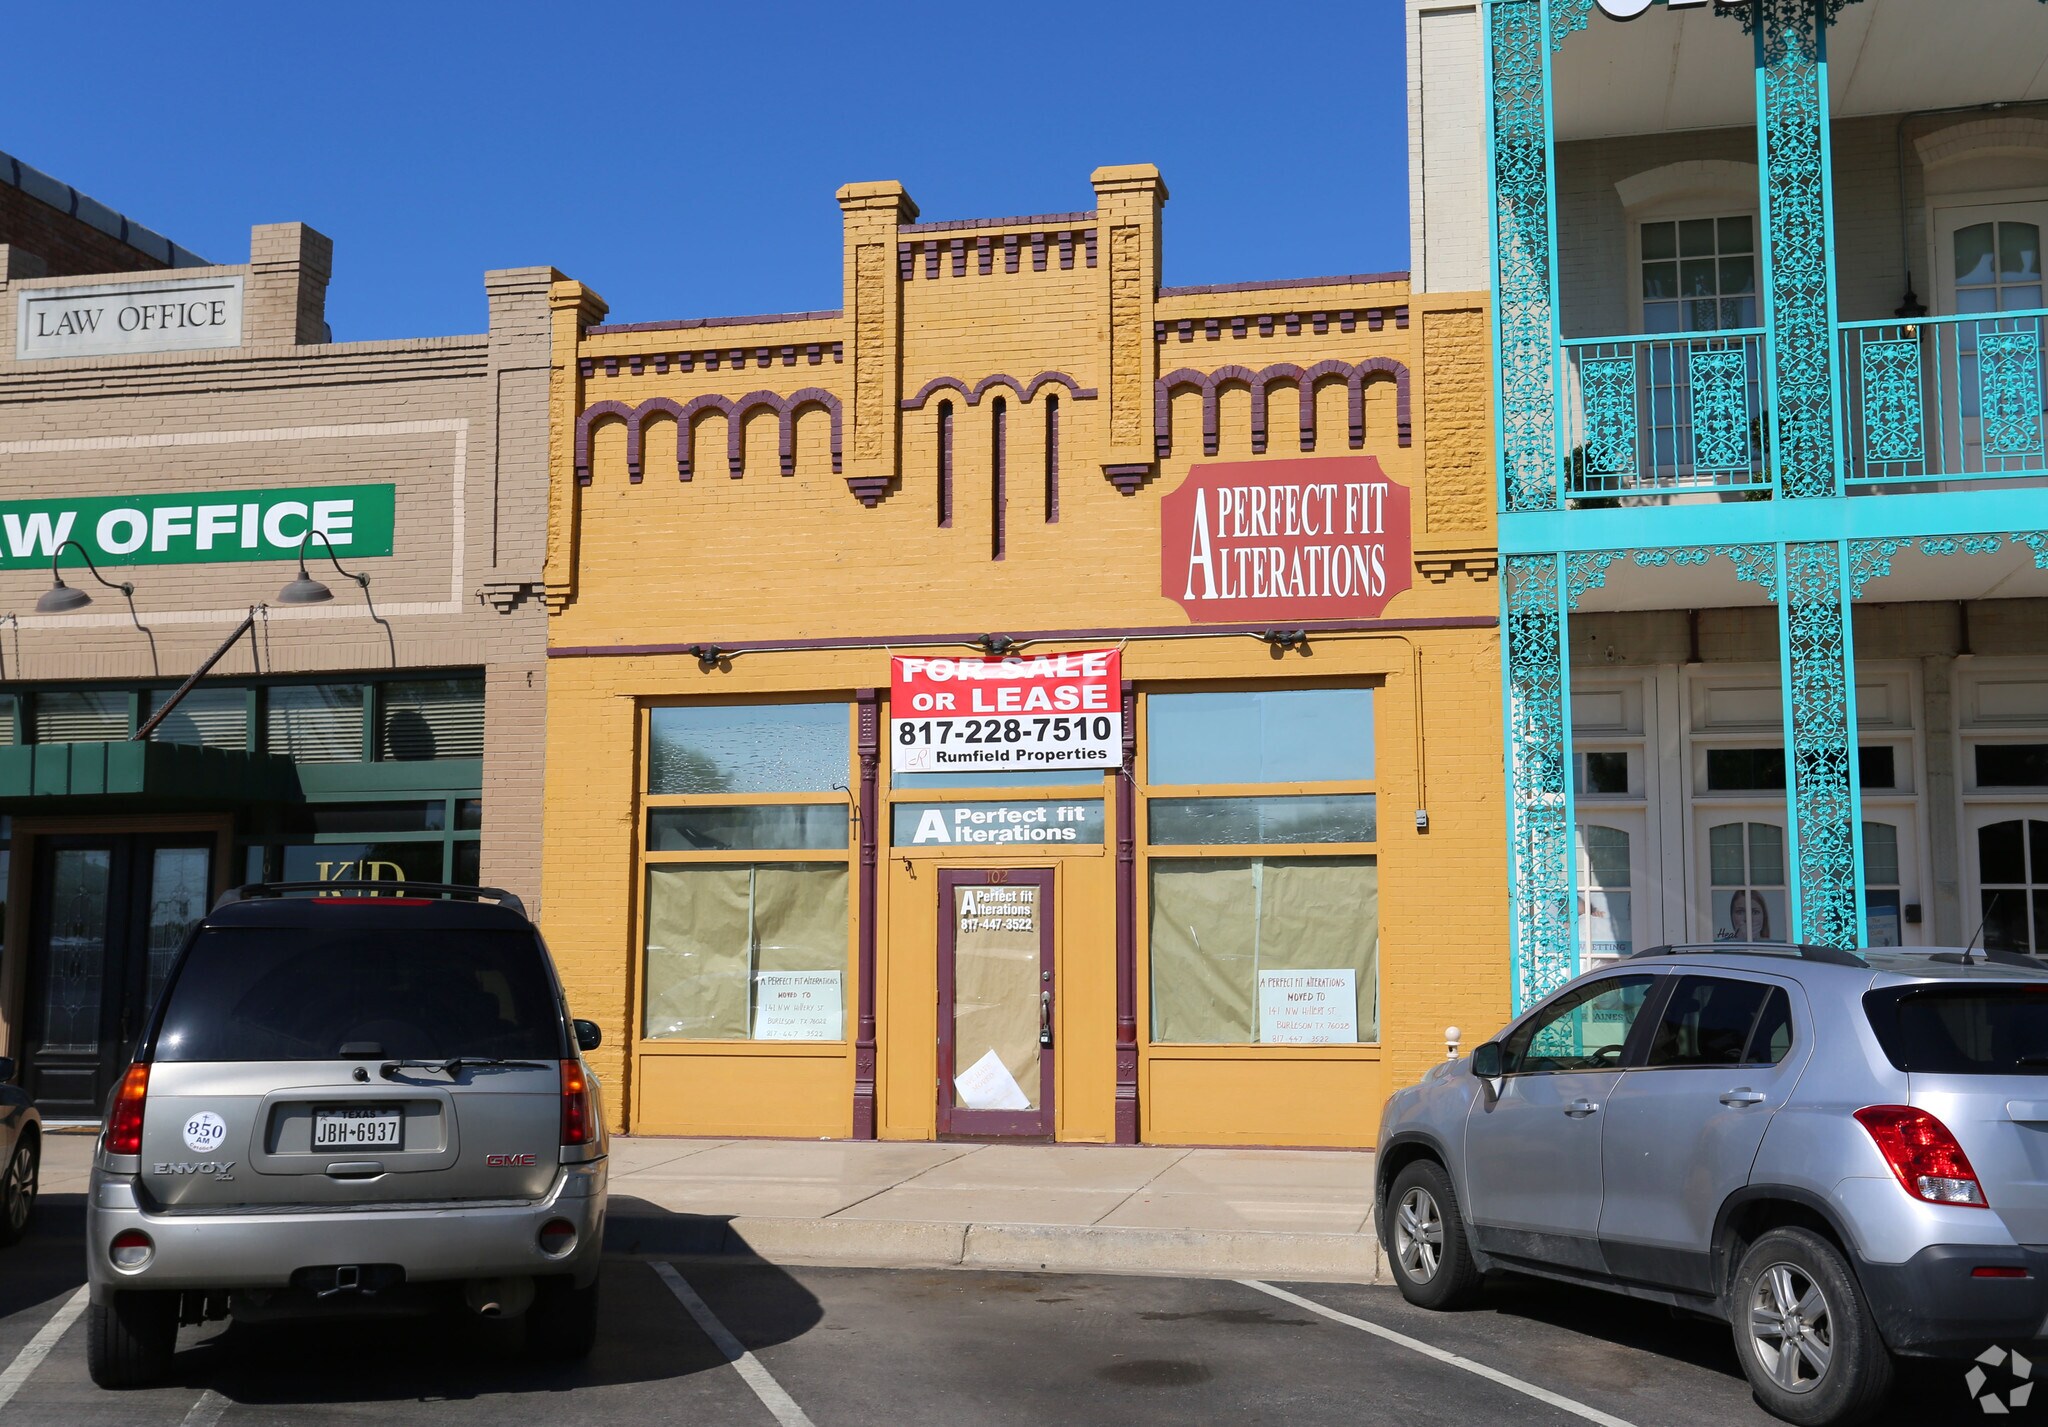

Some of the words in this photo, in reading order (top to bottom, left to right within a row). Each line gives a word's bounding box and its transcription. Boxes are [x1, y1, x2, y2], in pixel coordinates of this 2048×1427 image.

[37, 308, 104, 339] LAW
[117, 300, 227, 333] OFFICE
[1217, 483, 1338, 538] PERFECT
[1343, 482, 1388, 535] FIT
[96, 499, 354, 555] OFFICE
[902, 656, 986, 683] FOR
[1000, 652, 1107, 680] SALE
[912, 692, 956, 711] OR
[972, 684, 1109, 713] LEASE
[899, 716, 1112, 746] 817-228-7510
[936, 749, 1010, 763] Rumfield
[1016, 748, 1107, 764] Properties
[912, 809, 952, 844] A
[955, 807, 1048, 824] Perfect
[1057, 806, 1085, 822] fit
[987, 870, 1008, 883] 102
[960, 890, 977, 915] A
[976, 890, 1017, 902] Perfect
[1020, 890, 1033, 902] fit
[960, 918, 1032, 930] 817-447-3522
[768, 976, 792, 986] PERFECT
[1267, 977, 1293, 988] PERFECT
[1295, 977, 1304, 988] FIT
[1287, 992, 1314, 1002] MOVED
[1316, 992, 1326, 1002] TO
[1276, 1020, 1313, 1030] BURLESON
[1315, 1022, 1325, 1030] TX
[341, 1110, 376, 1119] TEXAS
[187, 1121, 223, 1139] 850
[195, 1136, 210, 1145] AM
[486, 1153, 536, 1167] GMC
[153, 1161, 236, 1176] ENVOY
